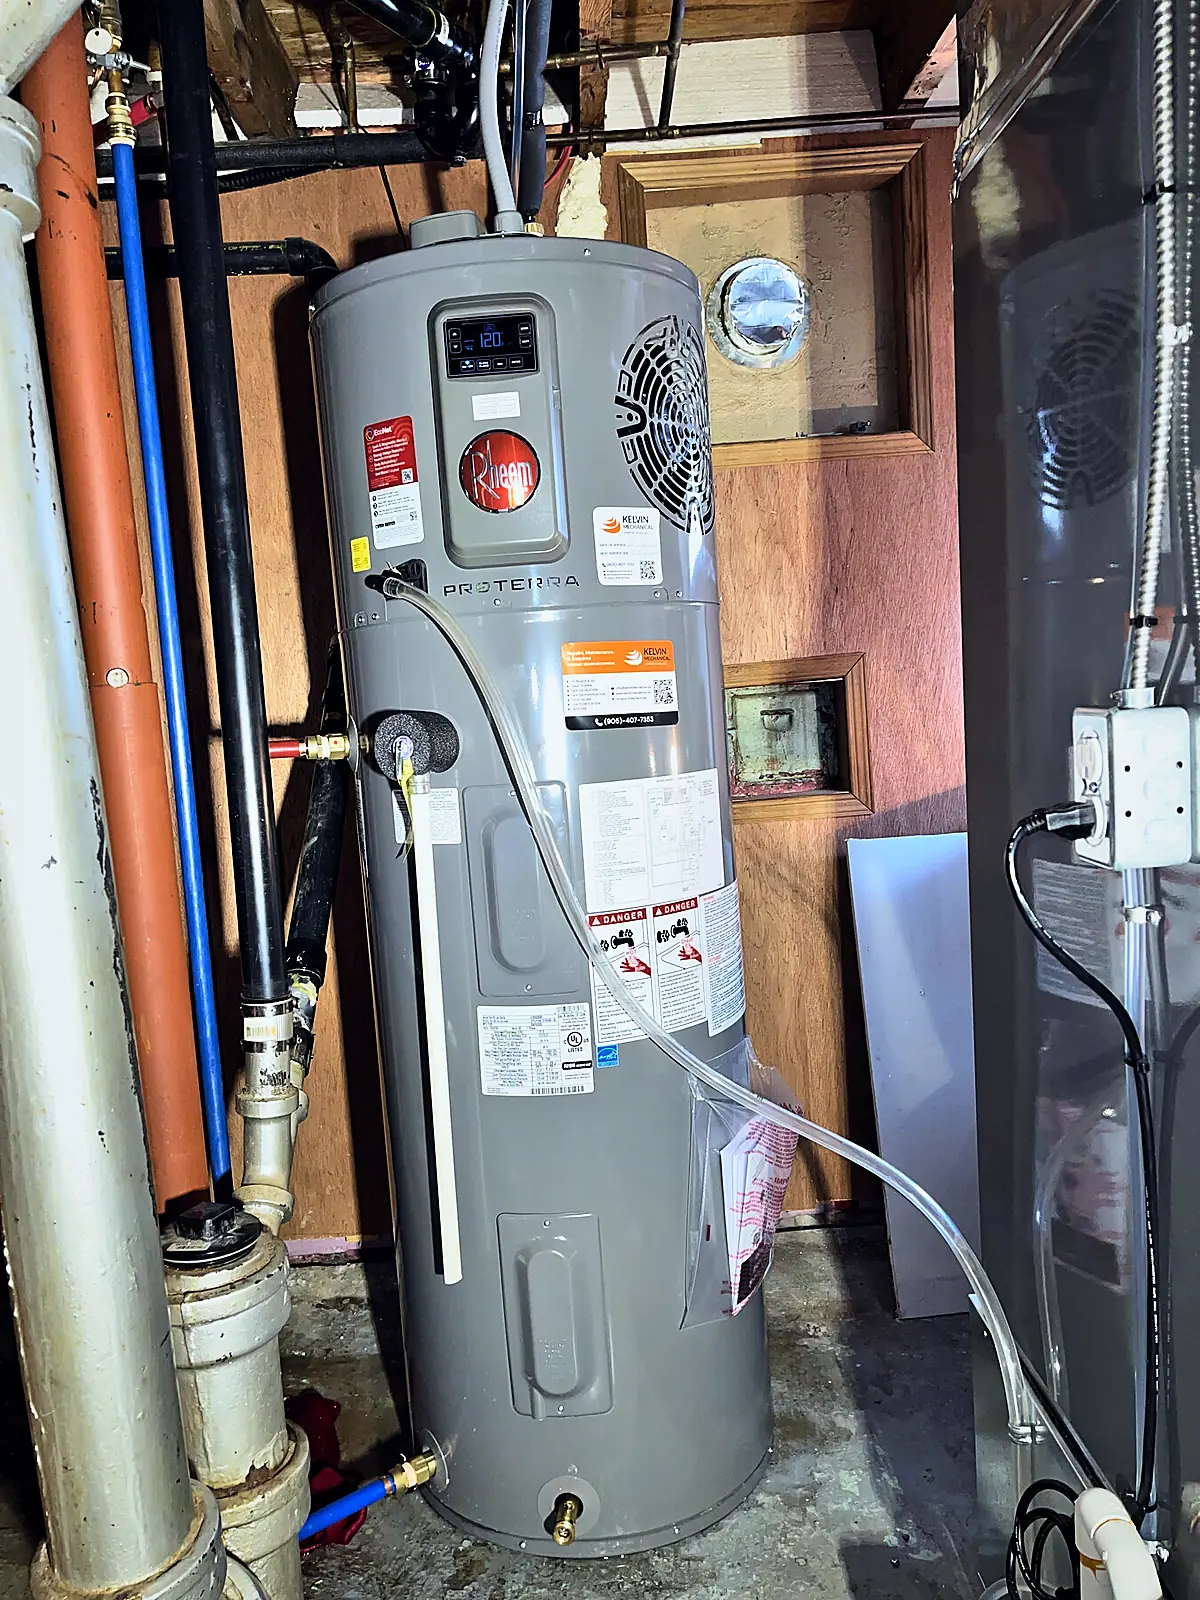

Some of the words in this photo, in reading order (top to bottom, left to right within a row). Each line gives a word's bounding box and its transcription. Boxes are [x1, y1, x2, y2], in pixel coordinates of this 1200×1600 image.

[480, 331, 501, 348] 120
[374, 426, 392, 436] EcoNet
[470, 440, 533, 499] Rheem
[622, 515, 649, 524] KELVIN
[443, 575, 580, 597] PROTERRA
[643, 647, 667, 656] KELVIN
[603, 715, 655, 726] (905)-407-7353
[664, 901, 696, 914] DANGER
[603, 911, 643, 924] DANGER
